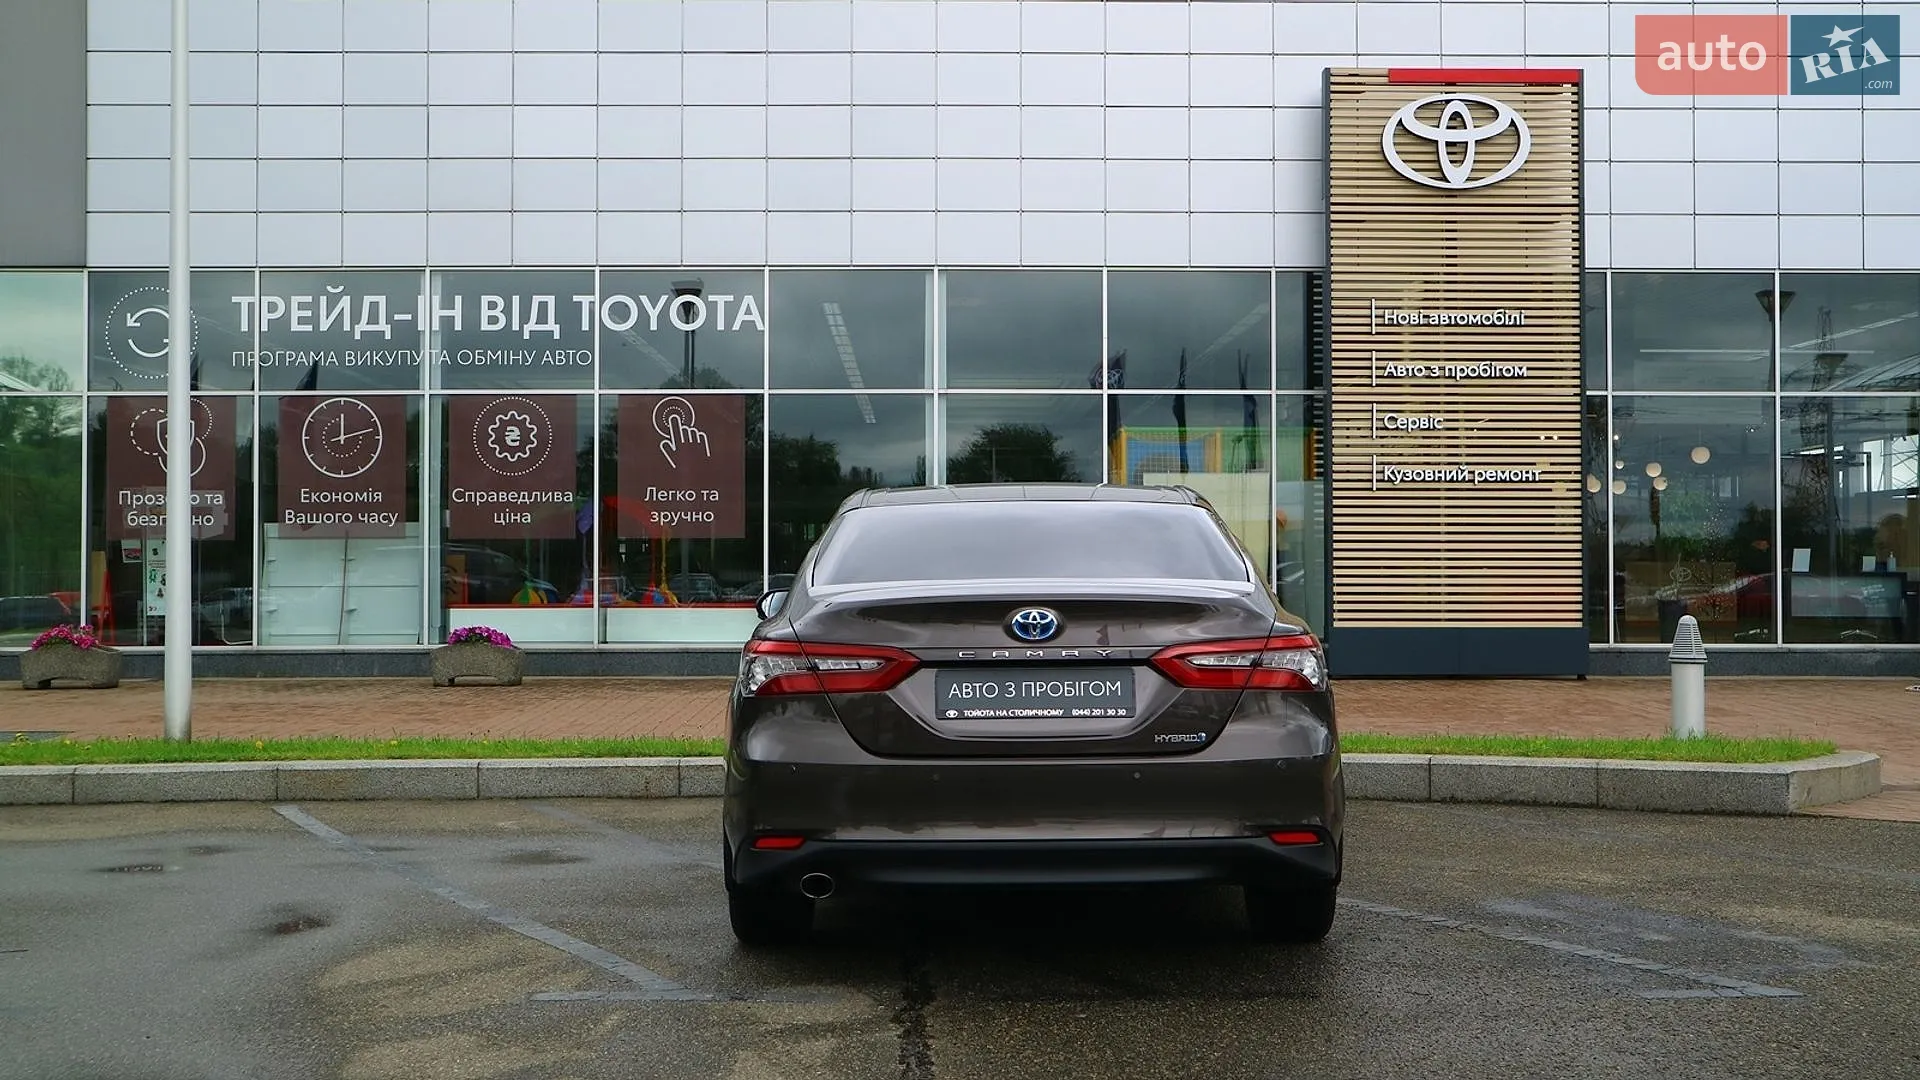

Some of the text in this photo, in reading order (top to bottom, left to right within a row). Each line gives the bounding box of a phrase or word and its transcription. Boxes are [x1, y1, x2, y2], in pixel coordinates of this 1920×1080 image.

[231, 285, 765, 340] ТРЕЙД-ІН ВІД TOYOTA
[1383, 309, 1526, 326] Нові автомобілі
[232, 349, 592, 367] ПРОГРАМА ВИКУПУ ТА ОБМІНУ АВТО
[1383, 361, 1528, 382] Авто з пробігом
[1383, 413, 1444, 434] Сервіс
[1383, 463, 1542, 485] Кузовний ремонт
[204, 494, 223, 505] та
[300, 488, 383, 503] Економія
[452, 488, 574, 506] Справедлива
[644, 487, 719, 502] Легко та
[285, 510, 399, 527] Вашого часу
[493, 508, 532, 526] ціна
[649, 509, 715, 526] зручно
[958, 649, 1112, 658] CAMRY
[948, 682, 999, 699] АВТО
[1021, 680, 1122, 697] ПРОБІГОМ
[963, 708, 995, 717] ТОЙОТА
[995, 709, 1008, 717] НА
[1009, 708, 1065, 717] СТОЛИЧНОМУ
[1091, 708, 1104, 716] 201
[1106, 708, 1116, 716] 30
[1117, 708, 1127, 716] 30
[1154, 734, 1198, 743] HYBRID
